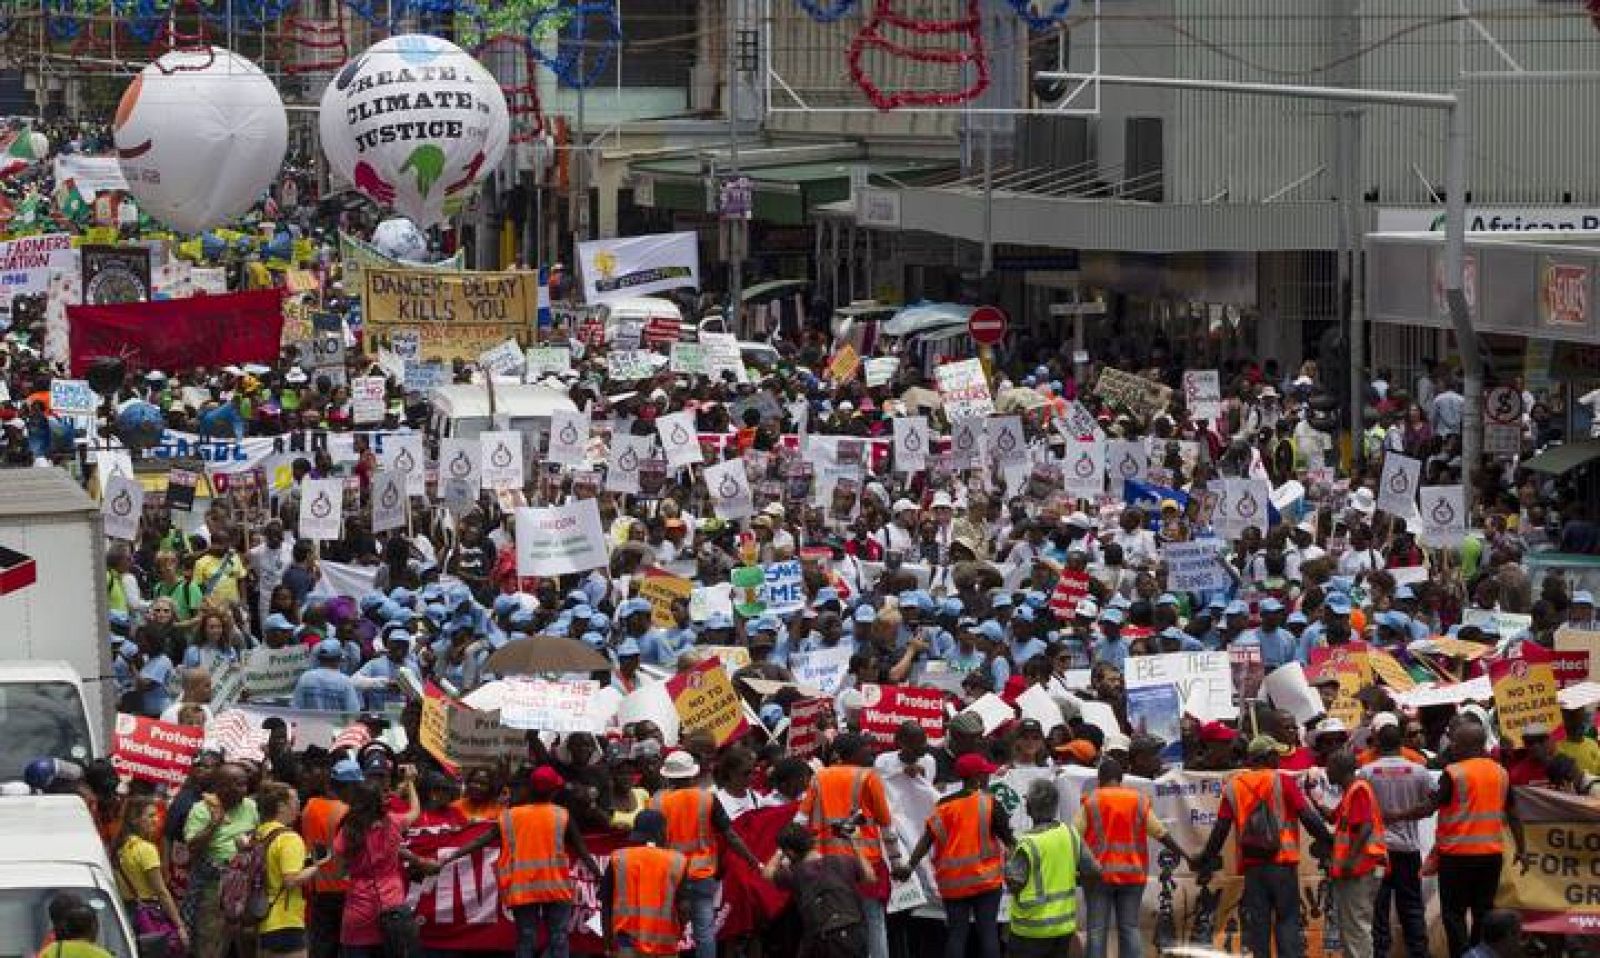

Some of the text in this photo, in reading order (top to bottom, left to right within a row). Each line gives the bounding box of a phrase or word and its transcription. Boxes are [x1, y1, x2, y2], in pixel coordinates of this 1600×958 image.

[346, 91, 473, 125] CLIMATE
[356, 120, 463, 152] JUSTICE
[462, 276, 517, 297] DELAY
[400, 300, 507, 321] KILLS YOU
[1136, 659, 1165, 680] BE
[1529, 682, 1545, 695] TO
[896, 693, 942, 710] Protect
[120, 738, 172, 760] Workers
[1525, 853, 1578, 876] FOR
